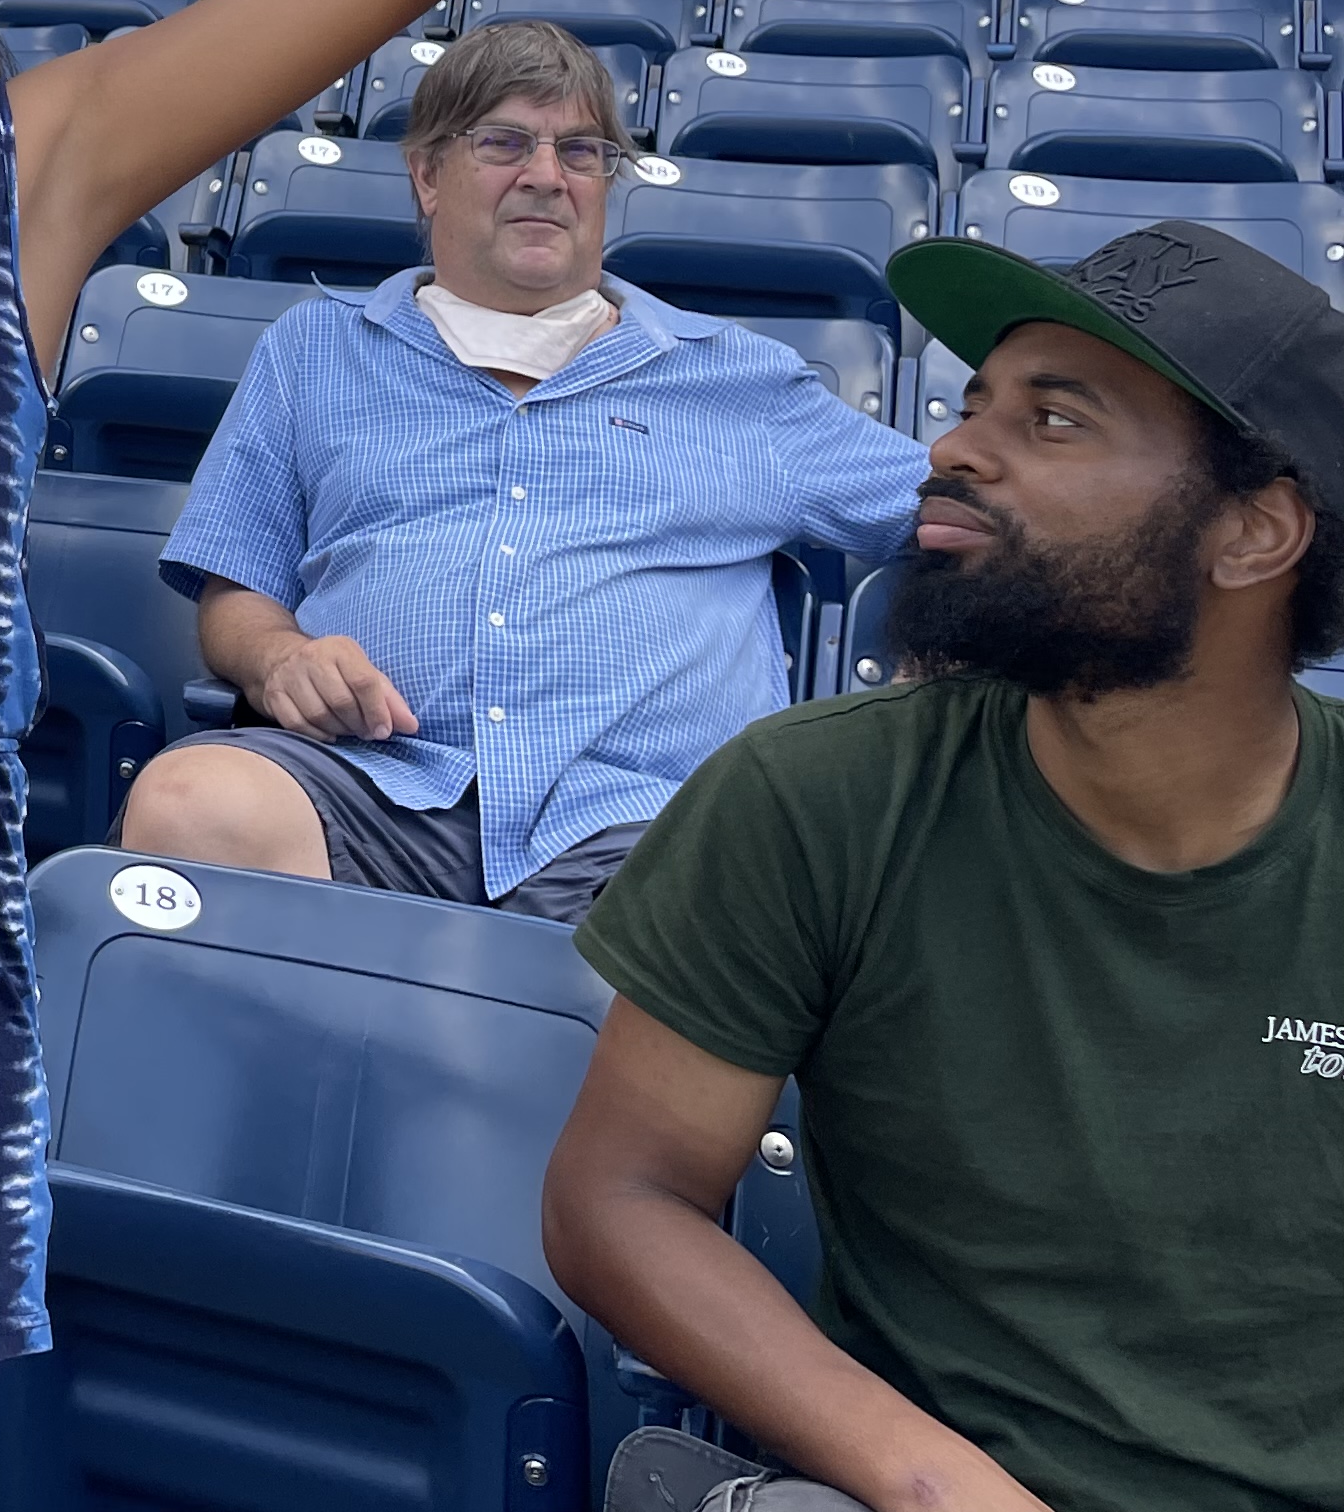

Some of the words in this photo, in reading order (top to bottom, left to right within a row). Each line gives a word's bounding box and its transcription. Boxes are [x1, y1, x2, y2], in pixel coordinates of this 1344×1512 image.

[420, 48, 438, 59] 17
[308, 144, 330, 158] 17
[646, 163, 669, 177] 18
[1022, 183, 1046, 198] 19
[148, 282, 174, 297] 17
[135, 882, 177, 911] 18
